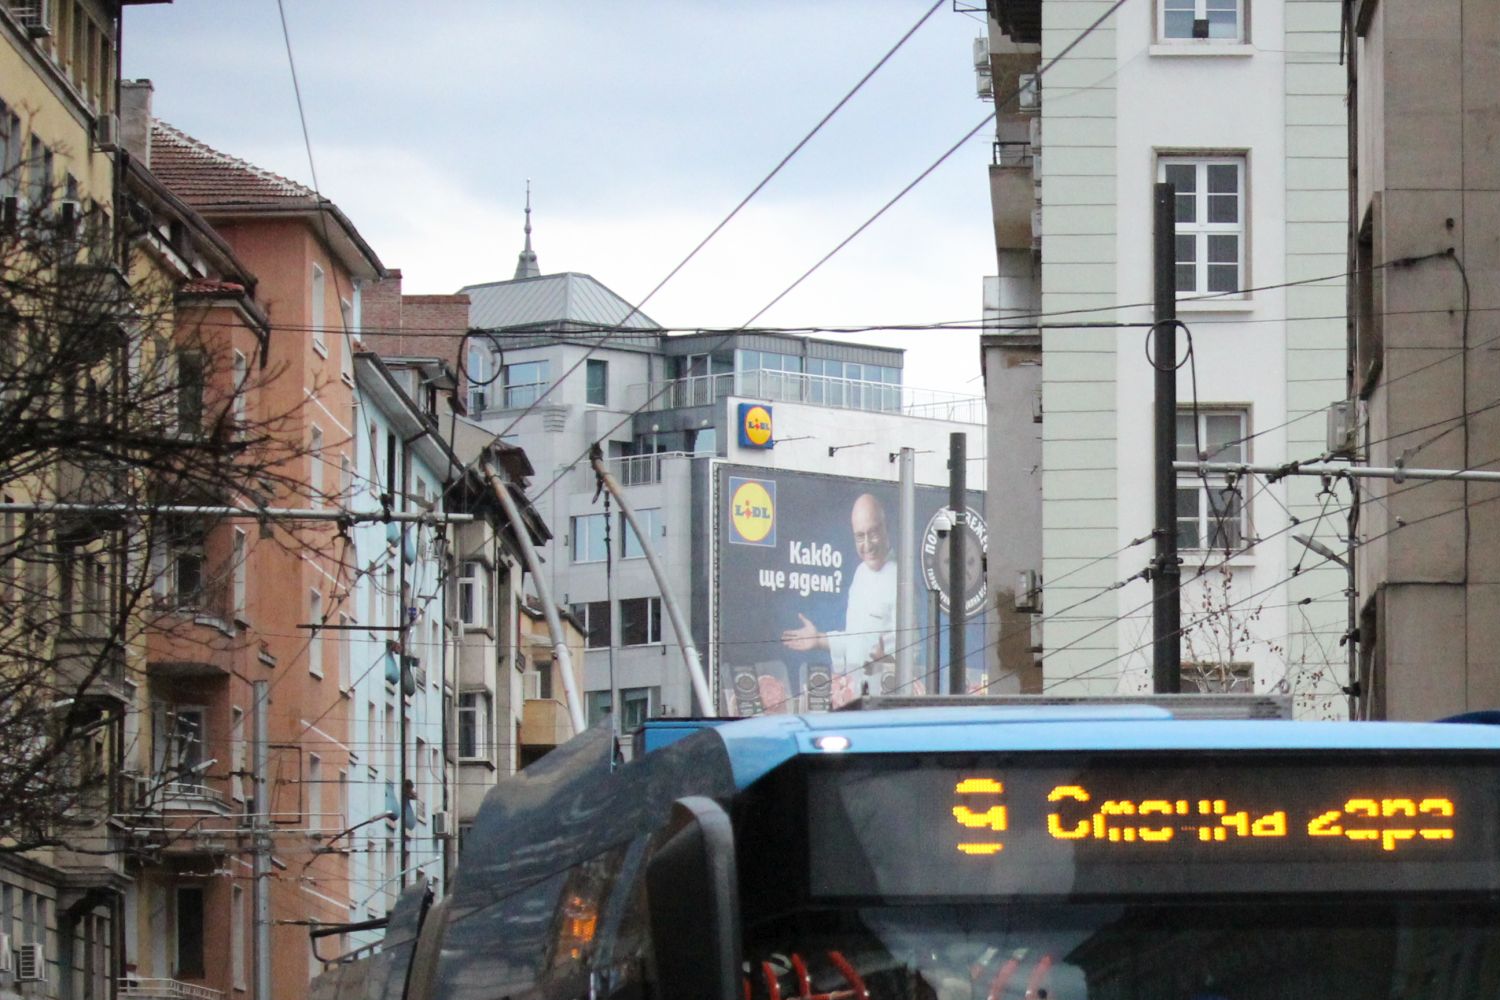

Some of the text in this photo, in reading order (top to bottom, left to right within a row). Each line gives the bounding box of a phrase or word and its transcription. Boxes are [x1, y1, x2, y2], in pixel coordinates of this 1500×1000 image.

[789, 541, 842, 568] Какво
[759, 568, 842, 596] ще ядем?
